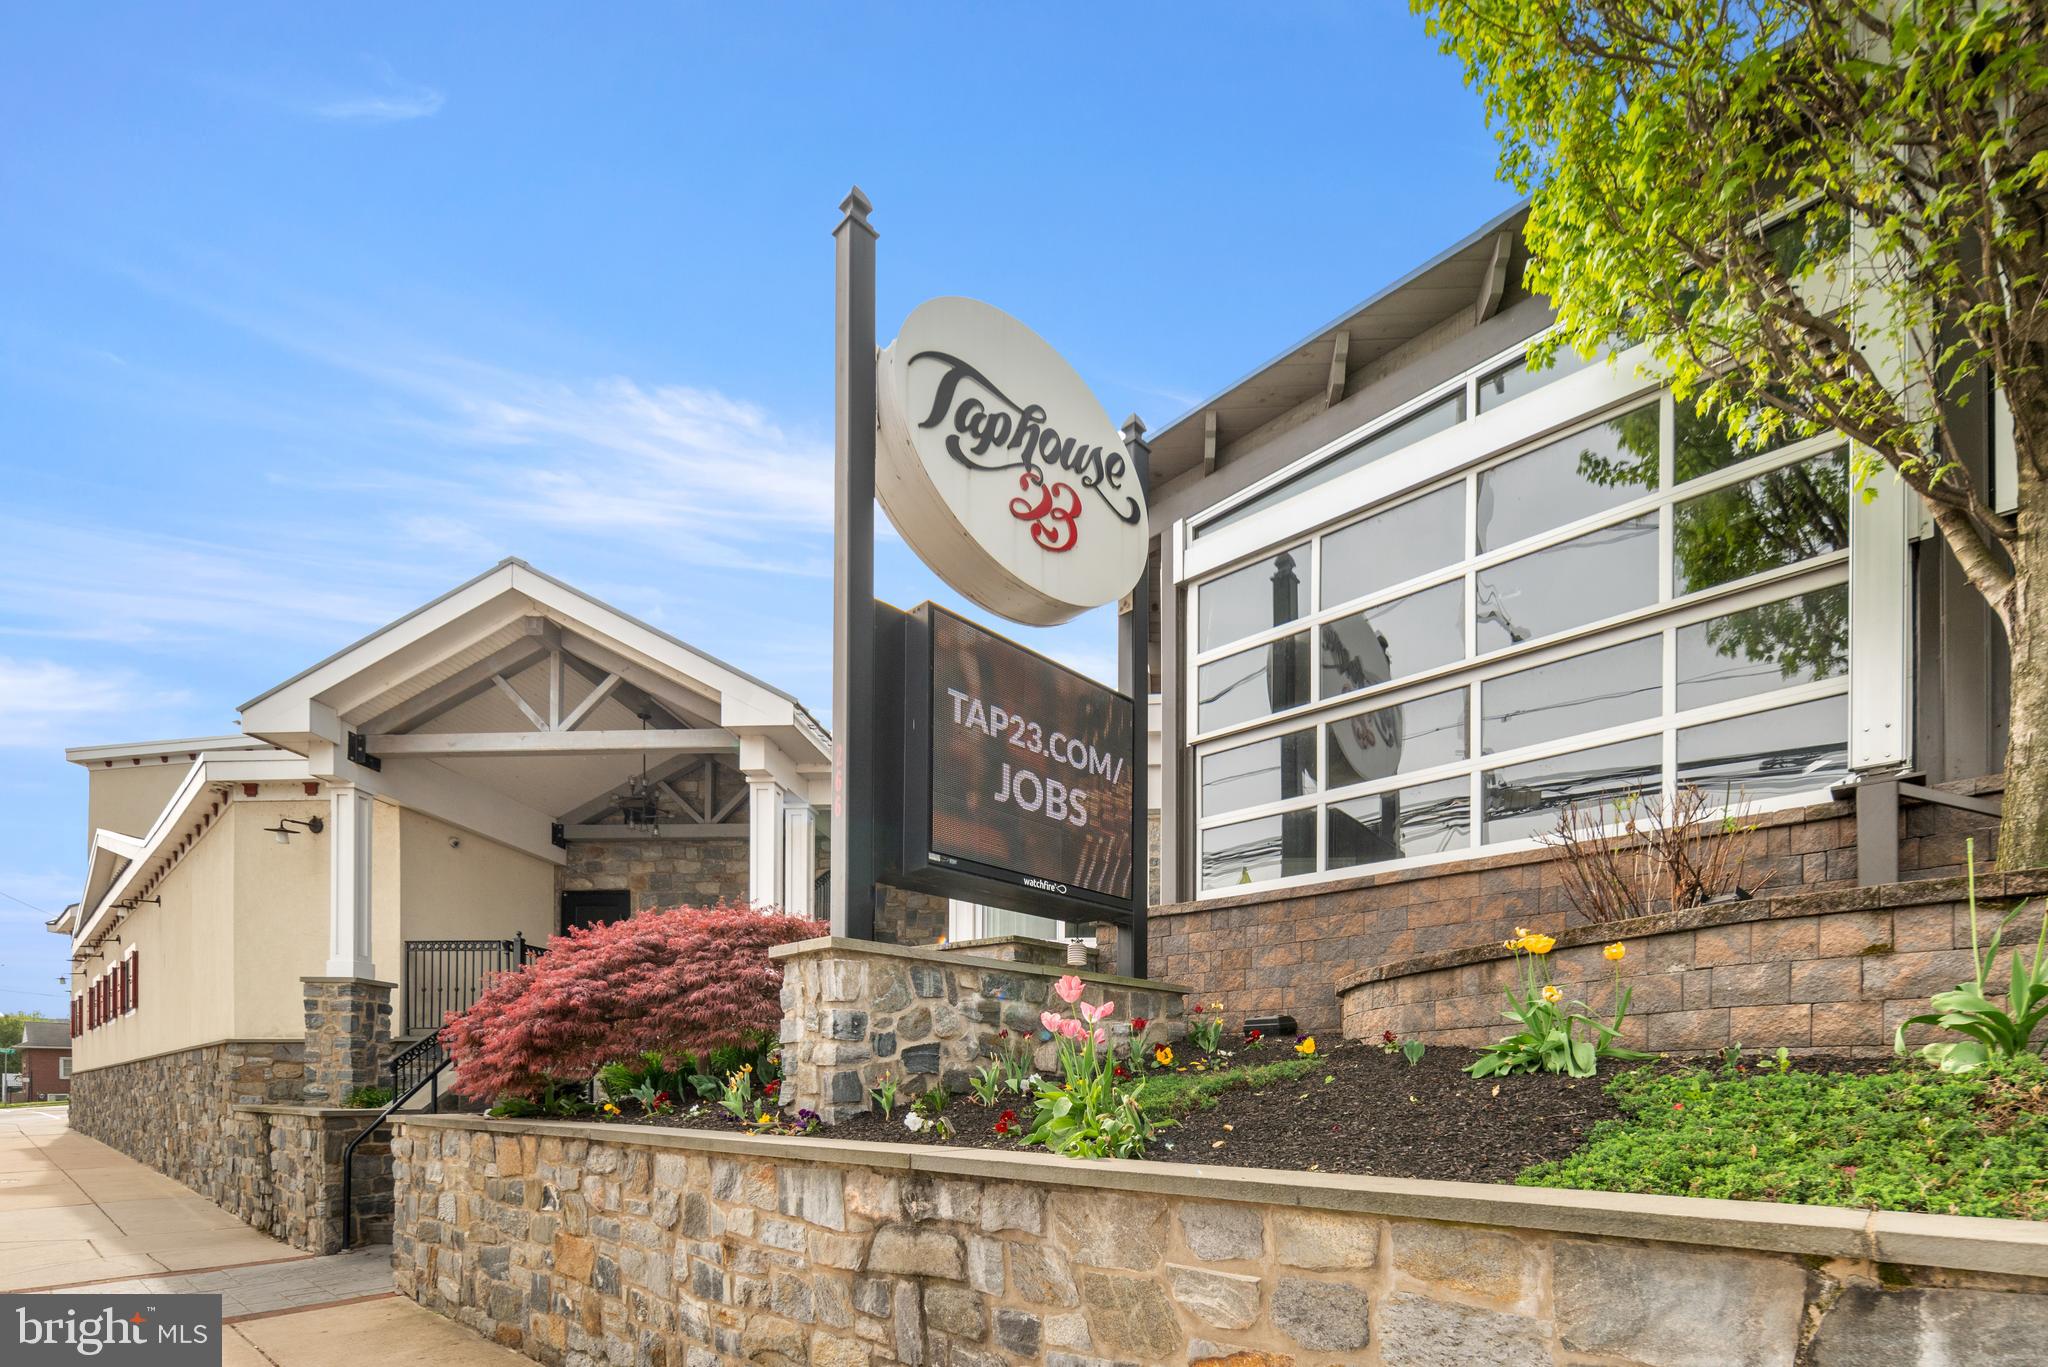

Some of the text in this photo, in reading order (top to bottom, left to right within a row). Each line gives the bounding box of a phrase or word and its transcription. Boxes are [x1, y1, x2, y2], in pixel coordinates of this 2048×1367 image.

[908, 351, 1141, 525] Taphouse
[1009, 471, 1082, 553] 23
[947, 687, 1124, 785] TAP23.COM/
[994, 762, 1088, 828] JOBS
[1023, 877, 1057, 892] watchfire
